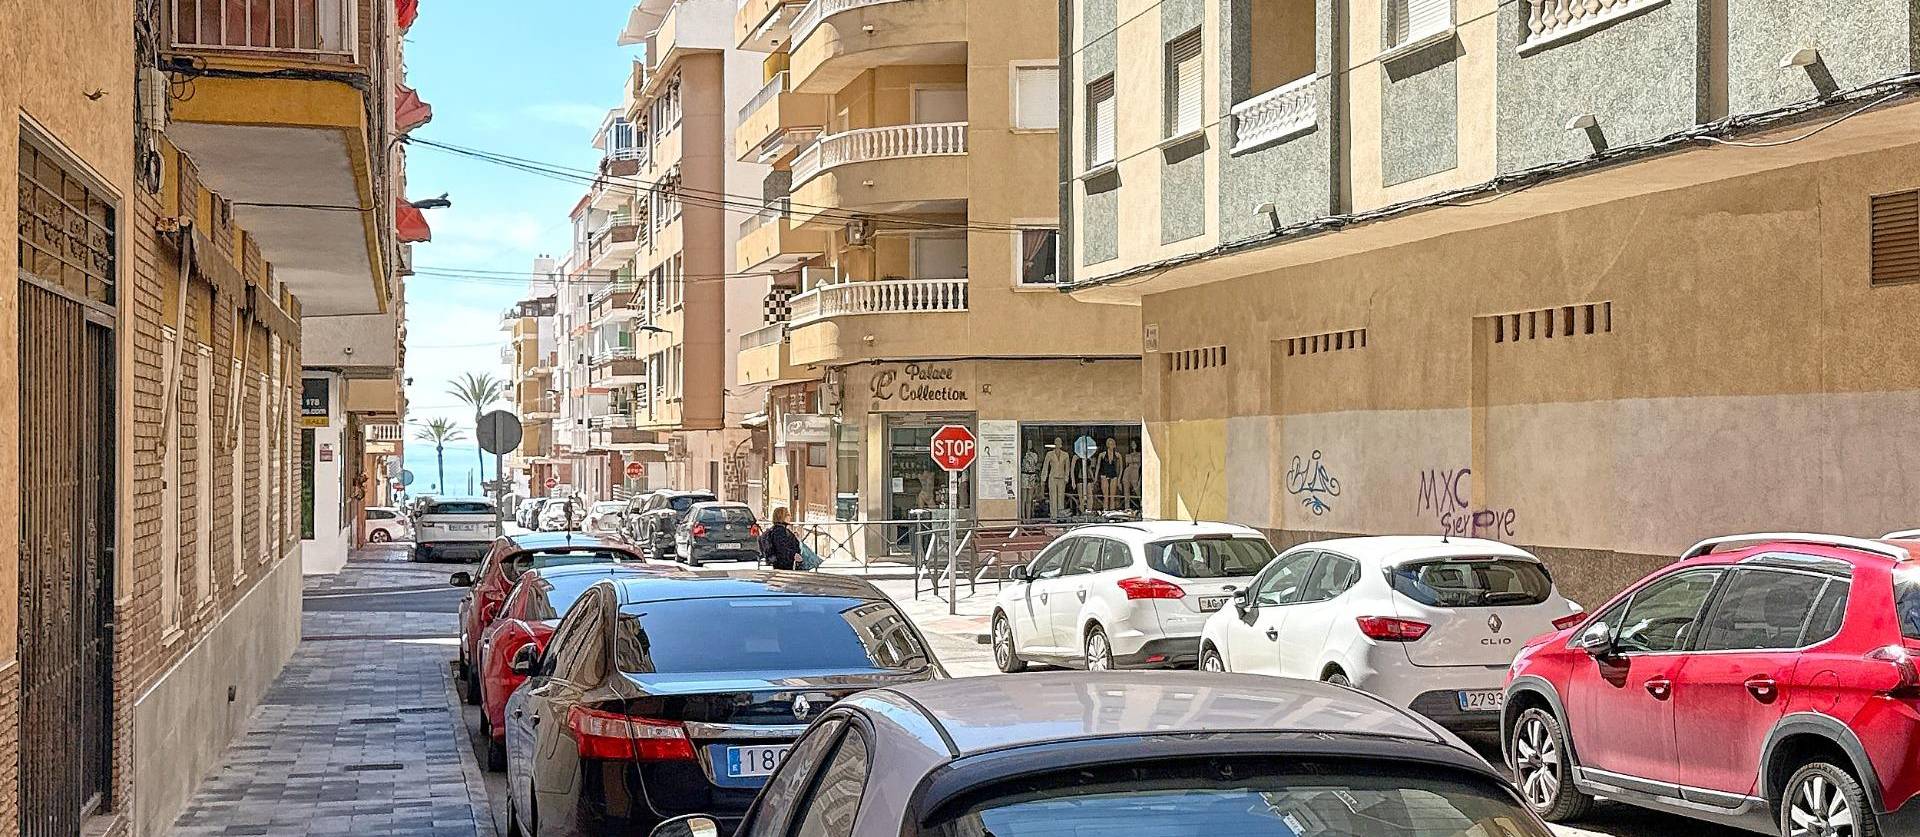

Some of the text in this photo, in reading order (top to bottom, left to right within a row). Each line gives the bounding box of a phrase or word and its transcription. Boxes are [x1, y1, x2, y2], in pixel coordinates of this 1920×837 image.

[905, 364, 952, 380] Palace
[900, 383, 968, 401] Collection
[934, 439, 974, 456] STOP
[1416, 468, 1471, 517] MXC
[1480, 637, 1512, 645] CLIO
[1469, 692, 1504, 707] 2793
